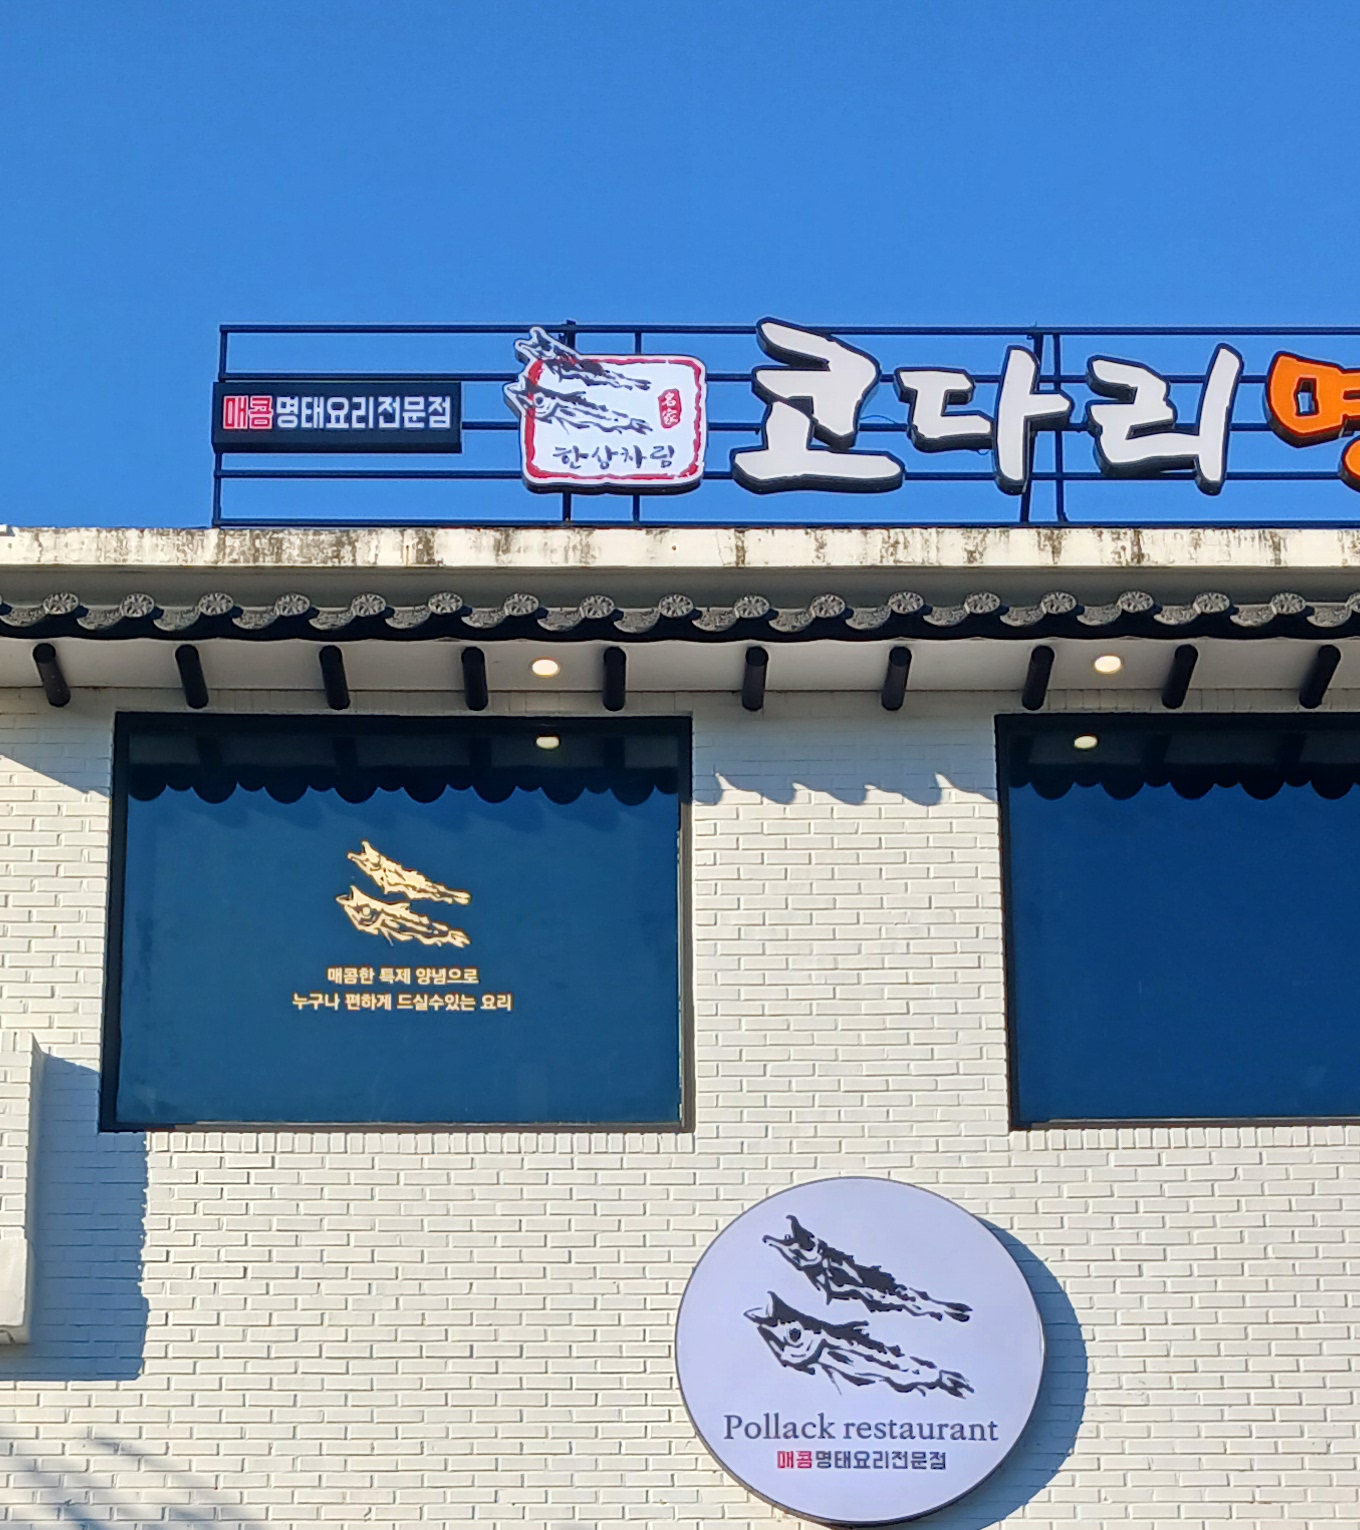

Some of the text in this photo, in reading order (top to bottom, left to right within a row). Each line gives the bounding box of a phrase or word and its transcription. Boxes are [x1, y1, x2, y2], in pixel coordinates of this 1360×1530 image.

[552, 444, 675, 470] 한상차림
[327, 967, 480, 985] 매콤한 특제 양념으로
[292, 993, 513, 1012] 누구나 편하게 드실수있는 요리
[723, 1413, 999, 1442] Pollack restaurant
